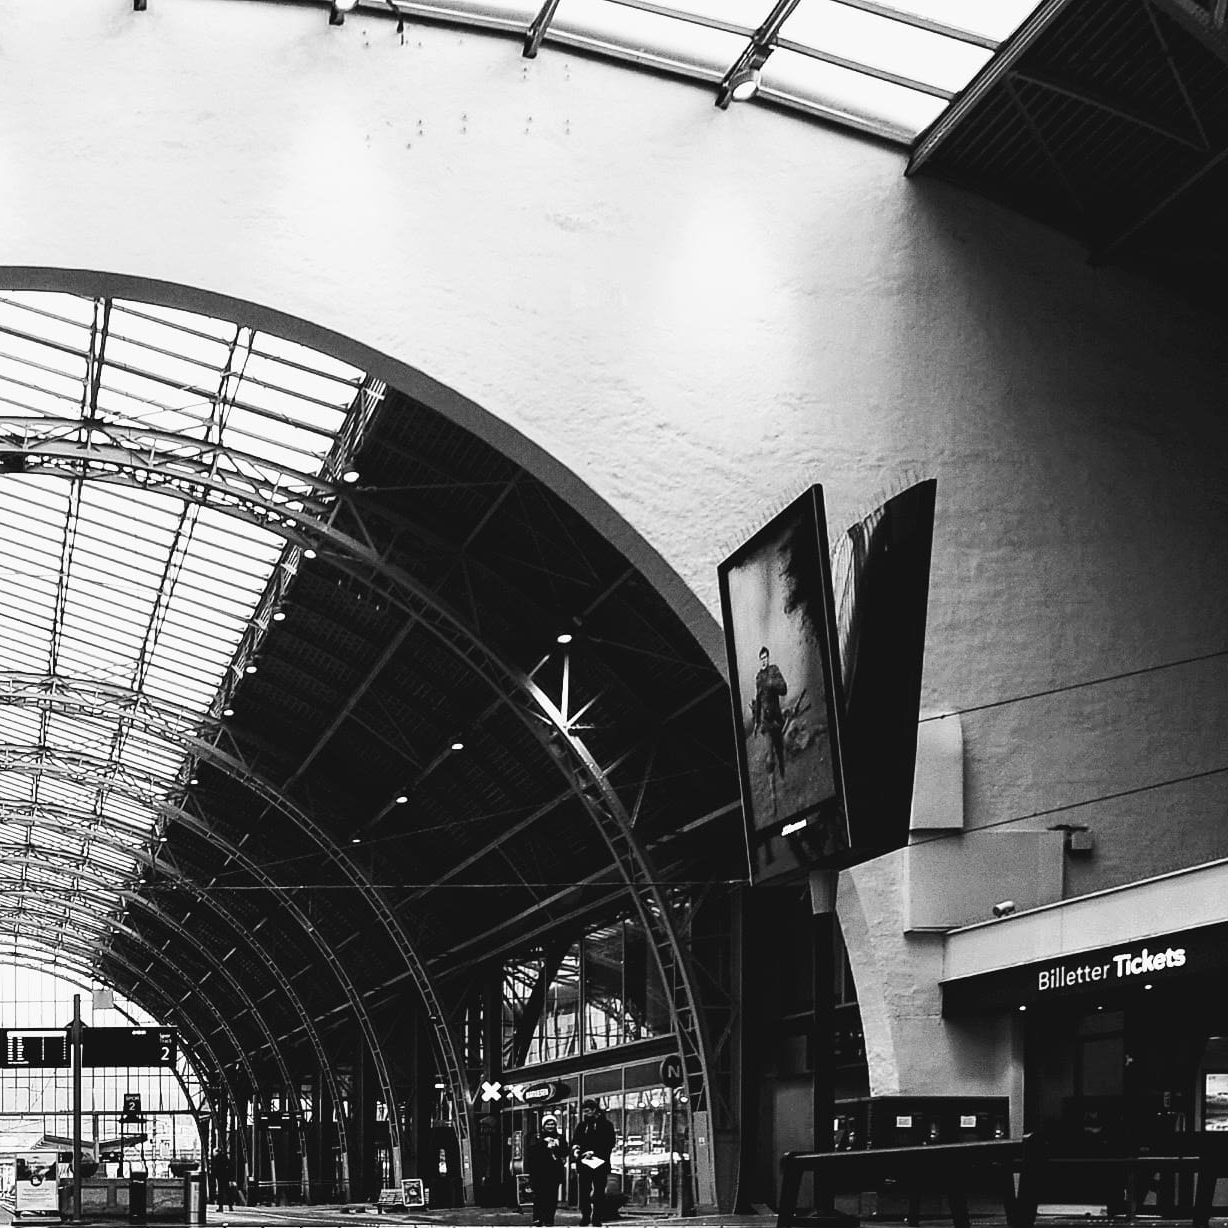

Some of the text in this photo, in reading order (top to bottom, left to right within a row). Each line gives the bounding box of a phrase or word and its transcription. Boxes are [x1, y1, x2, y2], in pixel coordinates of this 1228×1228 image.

[1038, 948, 1186, 991] Billetter Tickets
[161, 1046, 170, 1061] 2
[668, 1065, 680, 1078] N
[129, 1102, 136, 1111] 2
